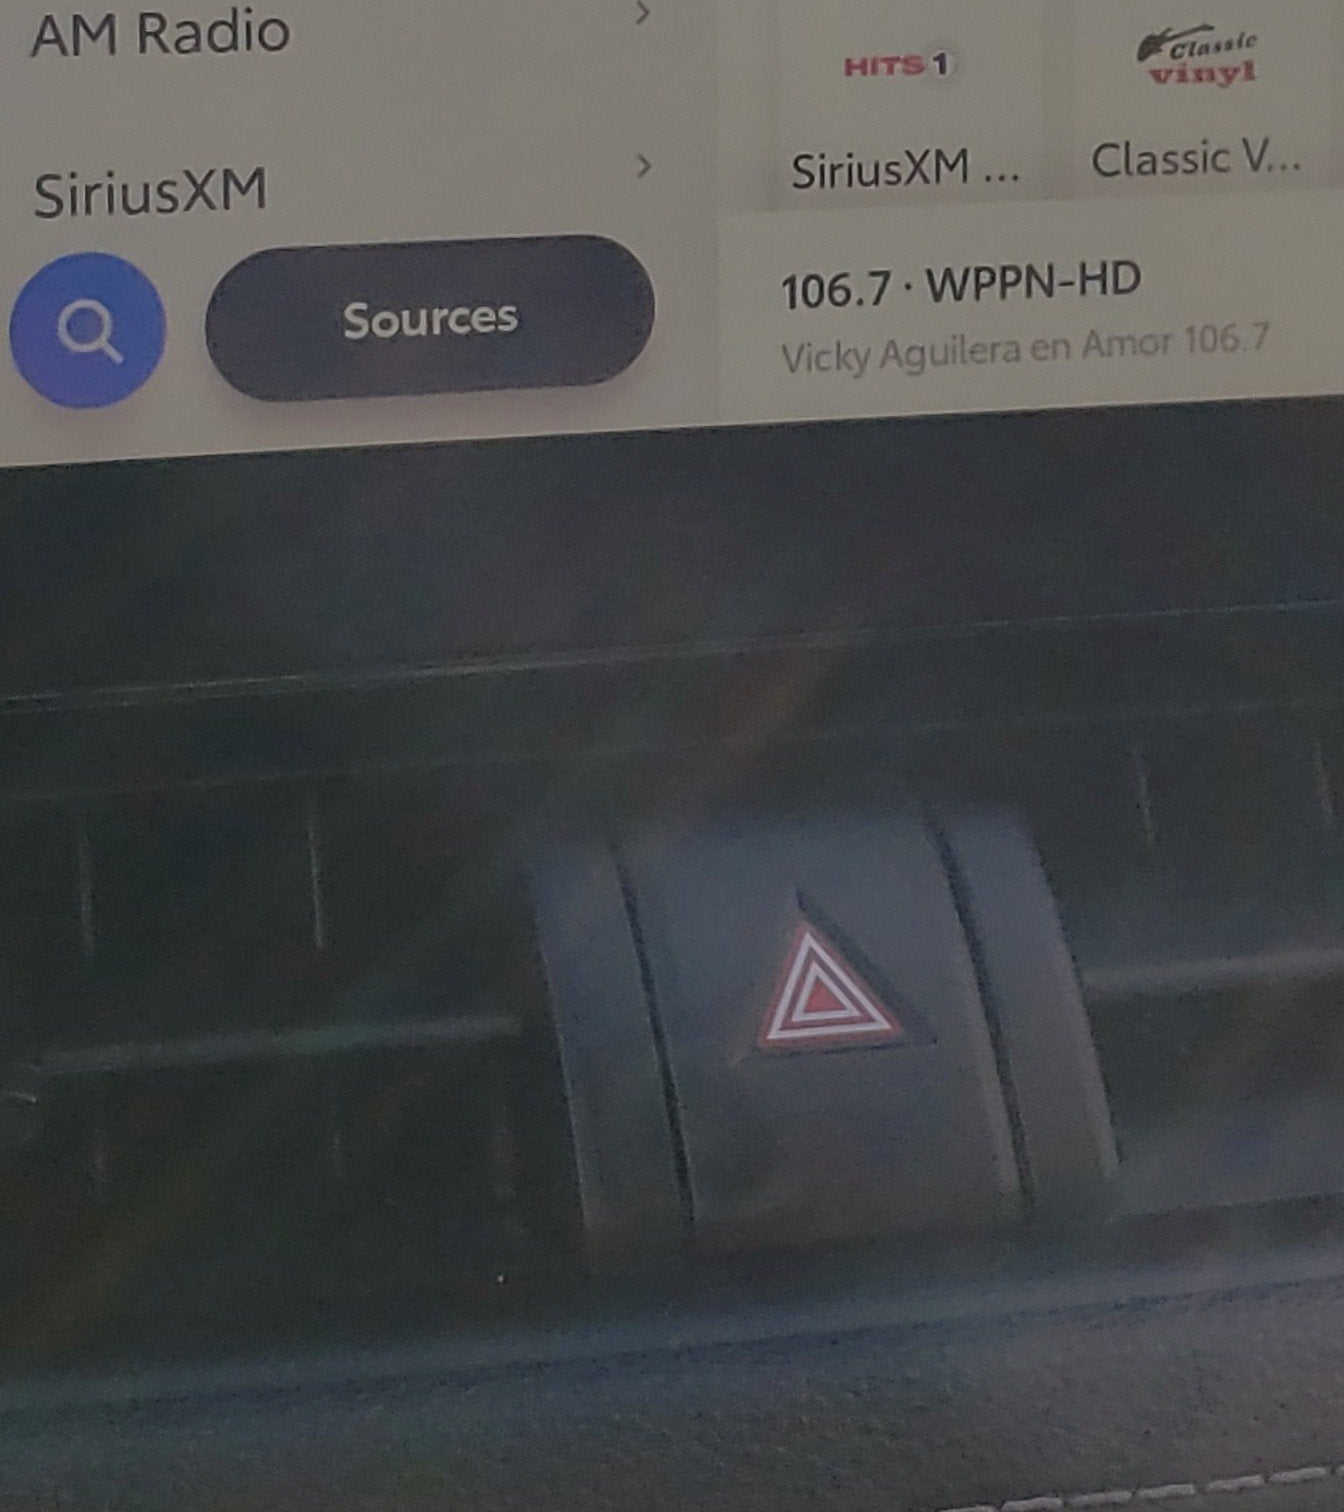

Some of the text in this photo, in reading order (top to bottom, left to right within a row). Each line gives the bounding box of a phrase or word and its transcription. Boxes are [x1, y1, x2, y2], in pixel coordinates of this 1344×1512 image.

[30, 6, 292, 58] AM Radio
[1170, 31, 1258, 60] Classic
[843, 51, 948, 77] HITS 1
[1148, 59, 1257, 88] vinyl
[792, 148, 968, 189] SiriusXM
[1092, 139, 1230, 178] Classic
[34, 165, 268, 219] SiriusXM
[782, 269, 892, 310] 106.7
[926, 260, 1142, 303] WPPN-HD
[343, 299, 520, 341] Sources
[782, 321, 1271, 379] Vicky Aguilera en Amor 106.7
